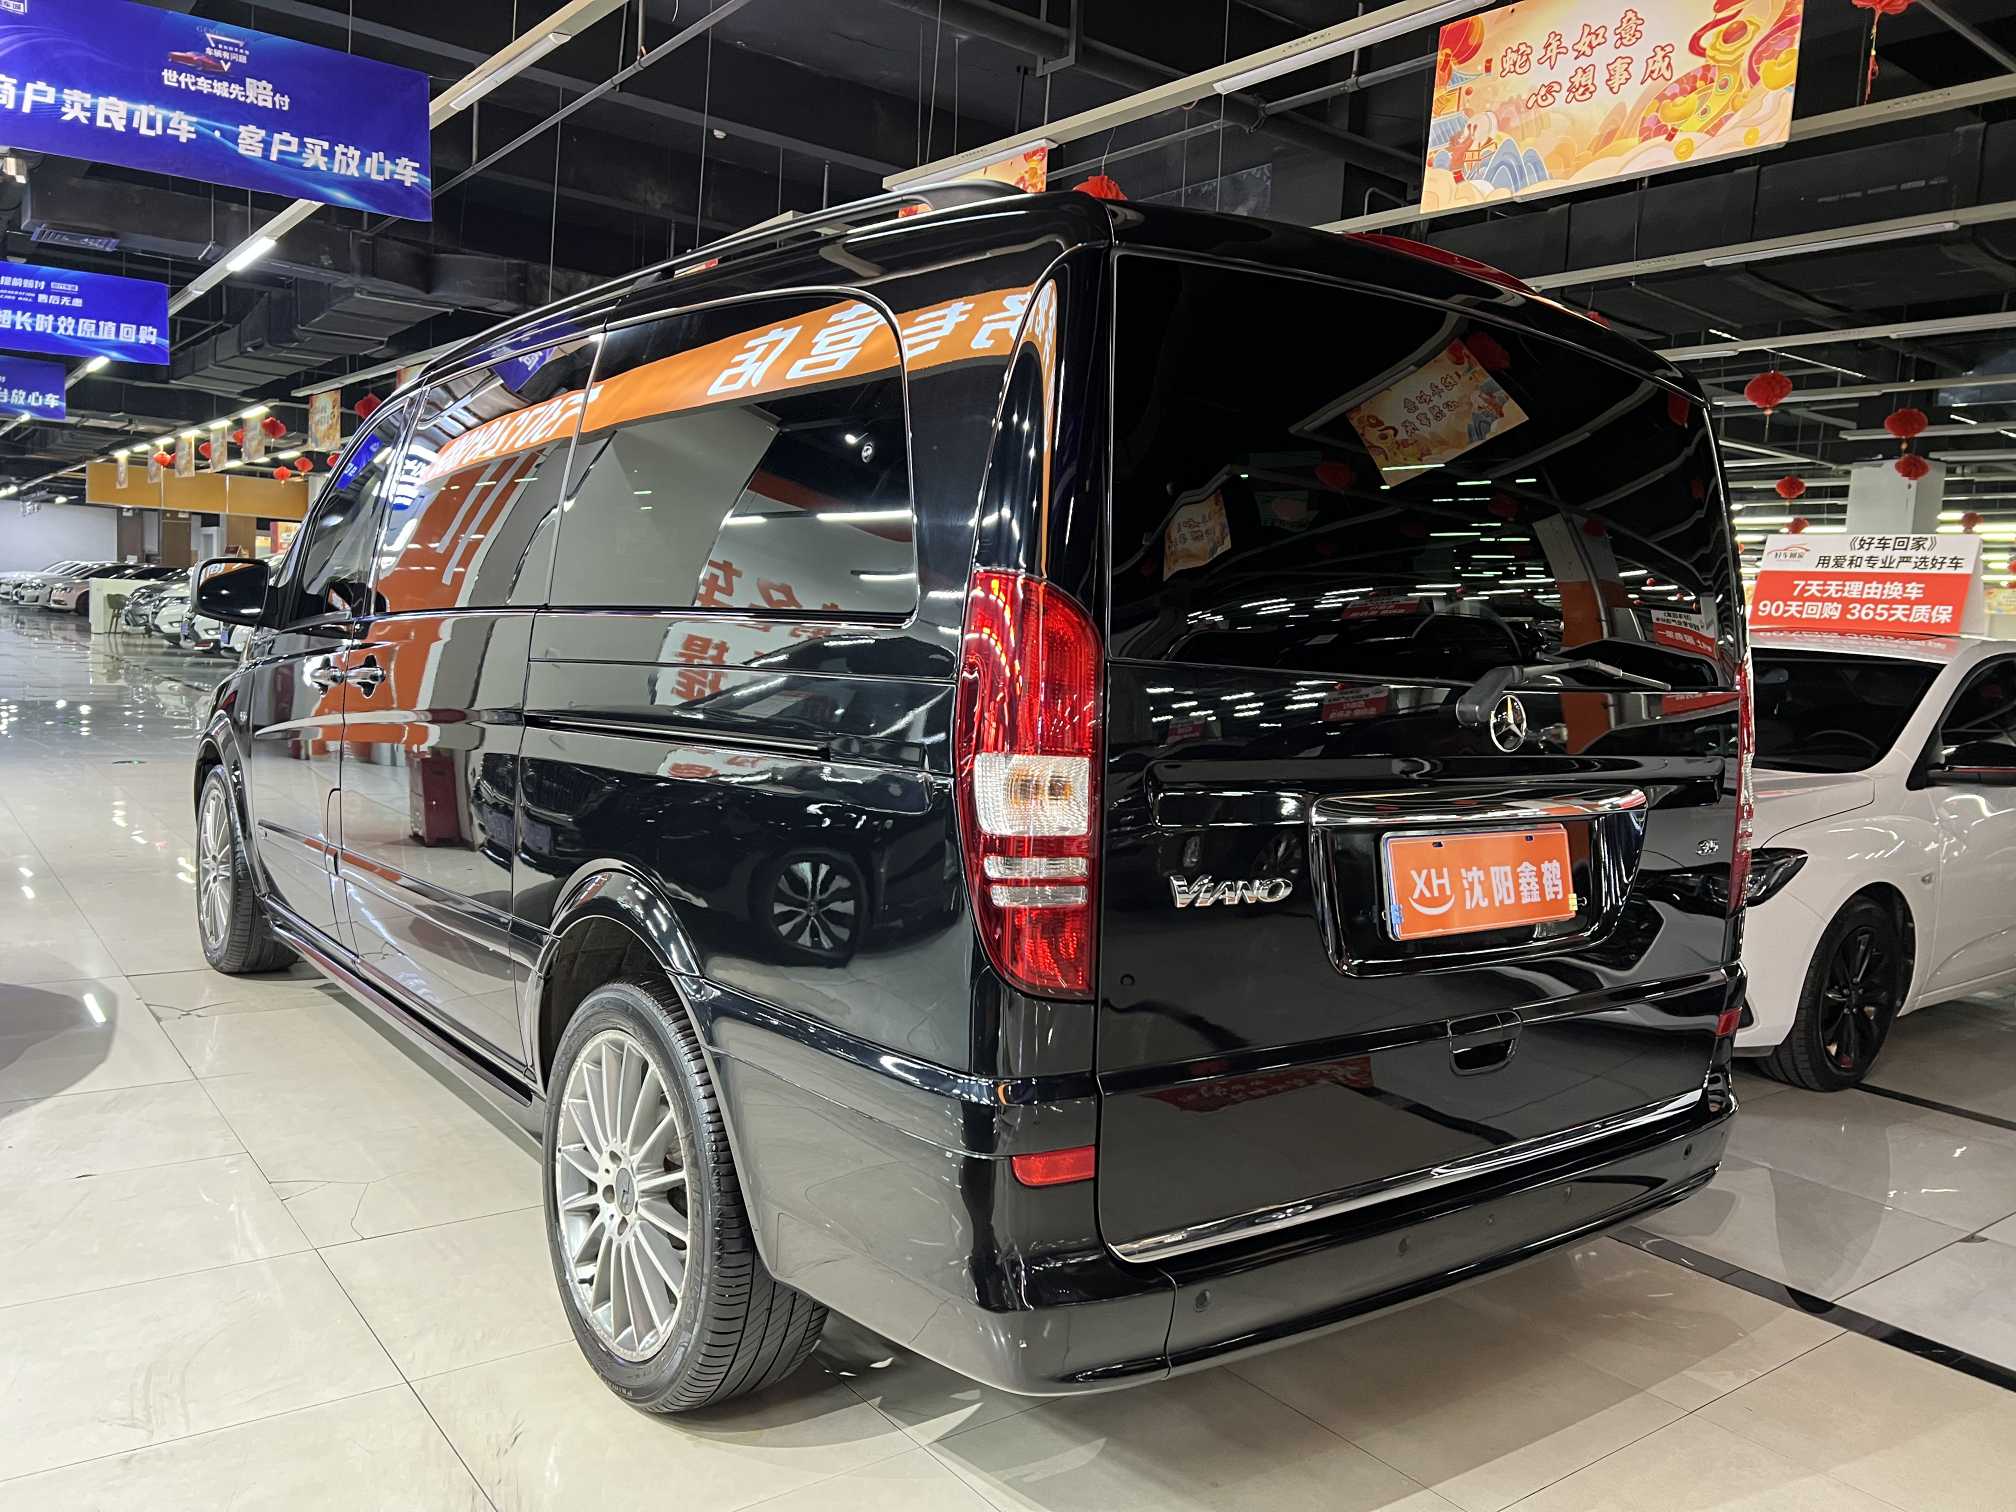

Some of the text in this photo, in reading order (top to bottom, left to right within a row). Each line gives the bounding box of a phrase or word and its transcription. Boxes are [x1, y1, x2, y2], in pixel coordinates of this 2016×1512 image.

[1500, 9, 1645, 77] 蛇年如意
[162, 69, 290, 110] 世代车城先赔付
[1526, 44, 1676, 109] 心想事成
[1849, 536, 1938, 552] 《好车回家》
[1816, 555, 1965, 571] 用爱和专业严选好车
[1792, 580, 1925, 601] 7天无理由换车
[1757, 600, 1953, 625] 90天回购 365天质保
[1169, 875, 1293, 908] VIANO
[1410, 859, 1564, 910] XH 沈阳鑫鹤
